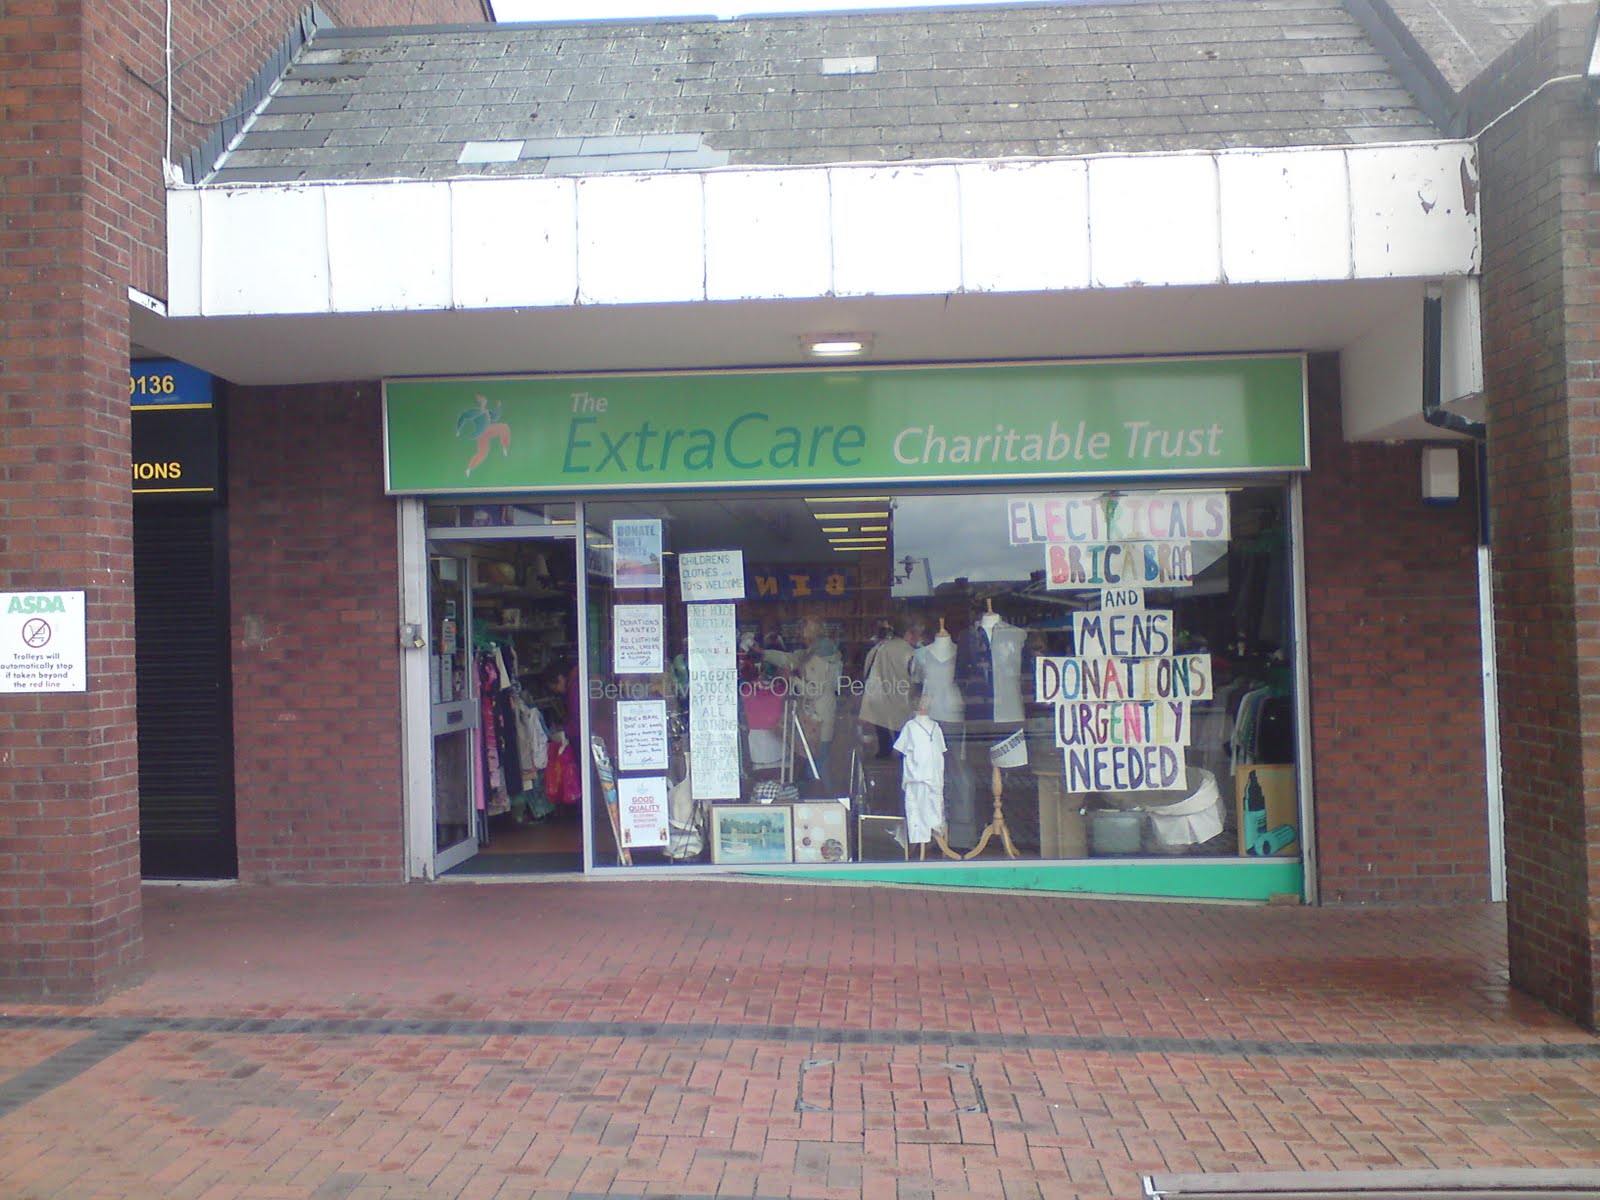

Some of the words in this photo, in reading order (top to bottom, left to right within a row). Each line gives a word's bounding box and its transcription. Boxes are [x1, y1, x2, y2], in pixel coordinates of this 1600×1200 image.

[570, 392, 608, 414] The
[562, 412, 867, 474] ExtraCare
[893, 420, 1110, 465] Charitable
[1123, 420, 1223, 459] Trust
[131, 462, 182, 480] IONS
[1009, 498, 1224, 544] ELECTRICALS
[681, 554, 731, 566] CHILDRENS
[1049, 544, 1121, 585] BRIC
[682, 567, 719, 579] CLOTHES
[1105, 589, 1138, 608] AND
[7, 595, 66, 615] ASDA
[620, 618, 660, 627] DONATIONS
[624, 626, 657, 634] WANTED
[1079, 613, 1170, 657] MENS
[13, 652, 45, 662] Trolleys
[46, 652, 60, 660] will
[0, 662, 54, 671] automatically
[56, 662, 74, 671] stop
[5, 671, 12, 679] if
[13, 671, 37, 680] taken
[38, 671, 69, 681] beyond
[691, 670, 737, 682] URGENT
[1042, 655, 1207, 701] DONATIONS
[13, 680, 27, 689] the
[29, 680, 44, 689] red
[45, 680, 61, 689] line
[588, 679, 651, 699] Better
[663, 679, 690, 698] Liv
[738, 681, 760, 697] or
[769, 676, 827, 697] Older
[837, 675, 911, 699] People
[694, 681, 734, 694] STOCK
[691, 694, 737, 706] APPEAL
[702, 706, 725, 718] ALL
[1058, 701, 1185, 746] URGENTLY
[1069, 746, 1179, 791] NEEDED
[631, 796, 655, 804] GOOD
[628, 804, 661, 813] QUALITY
